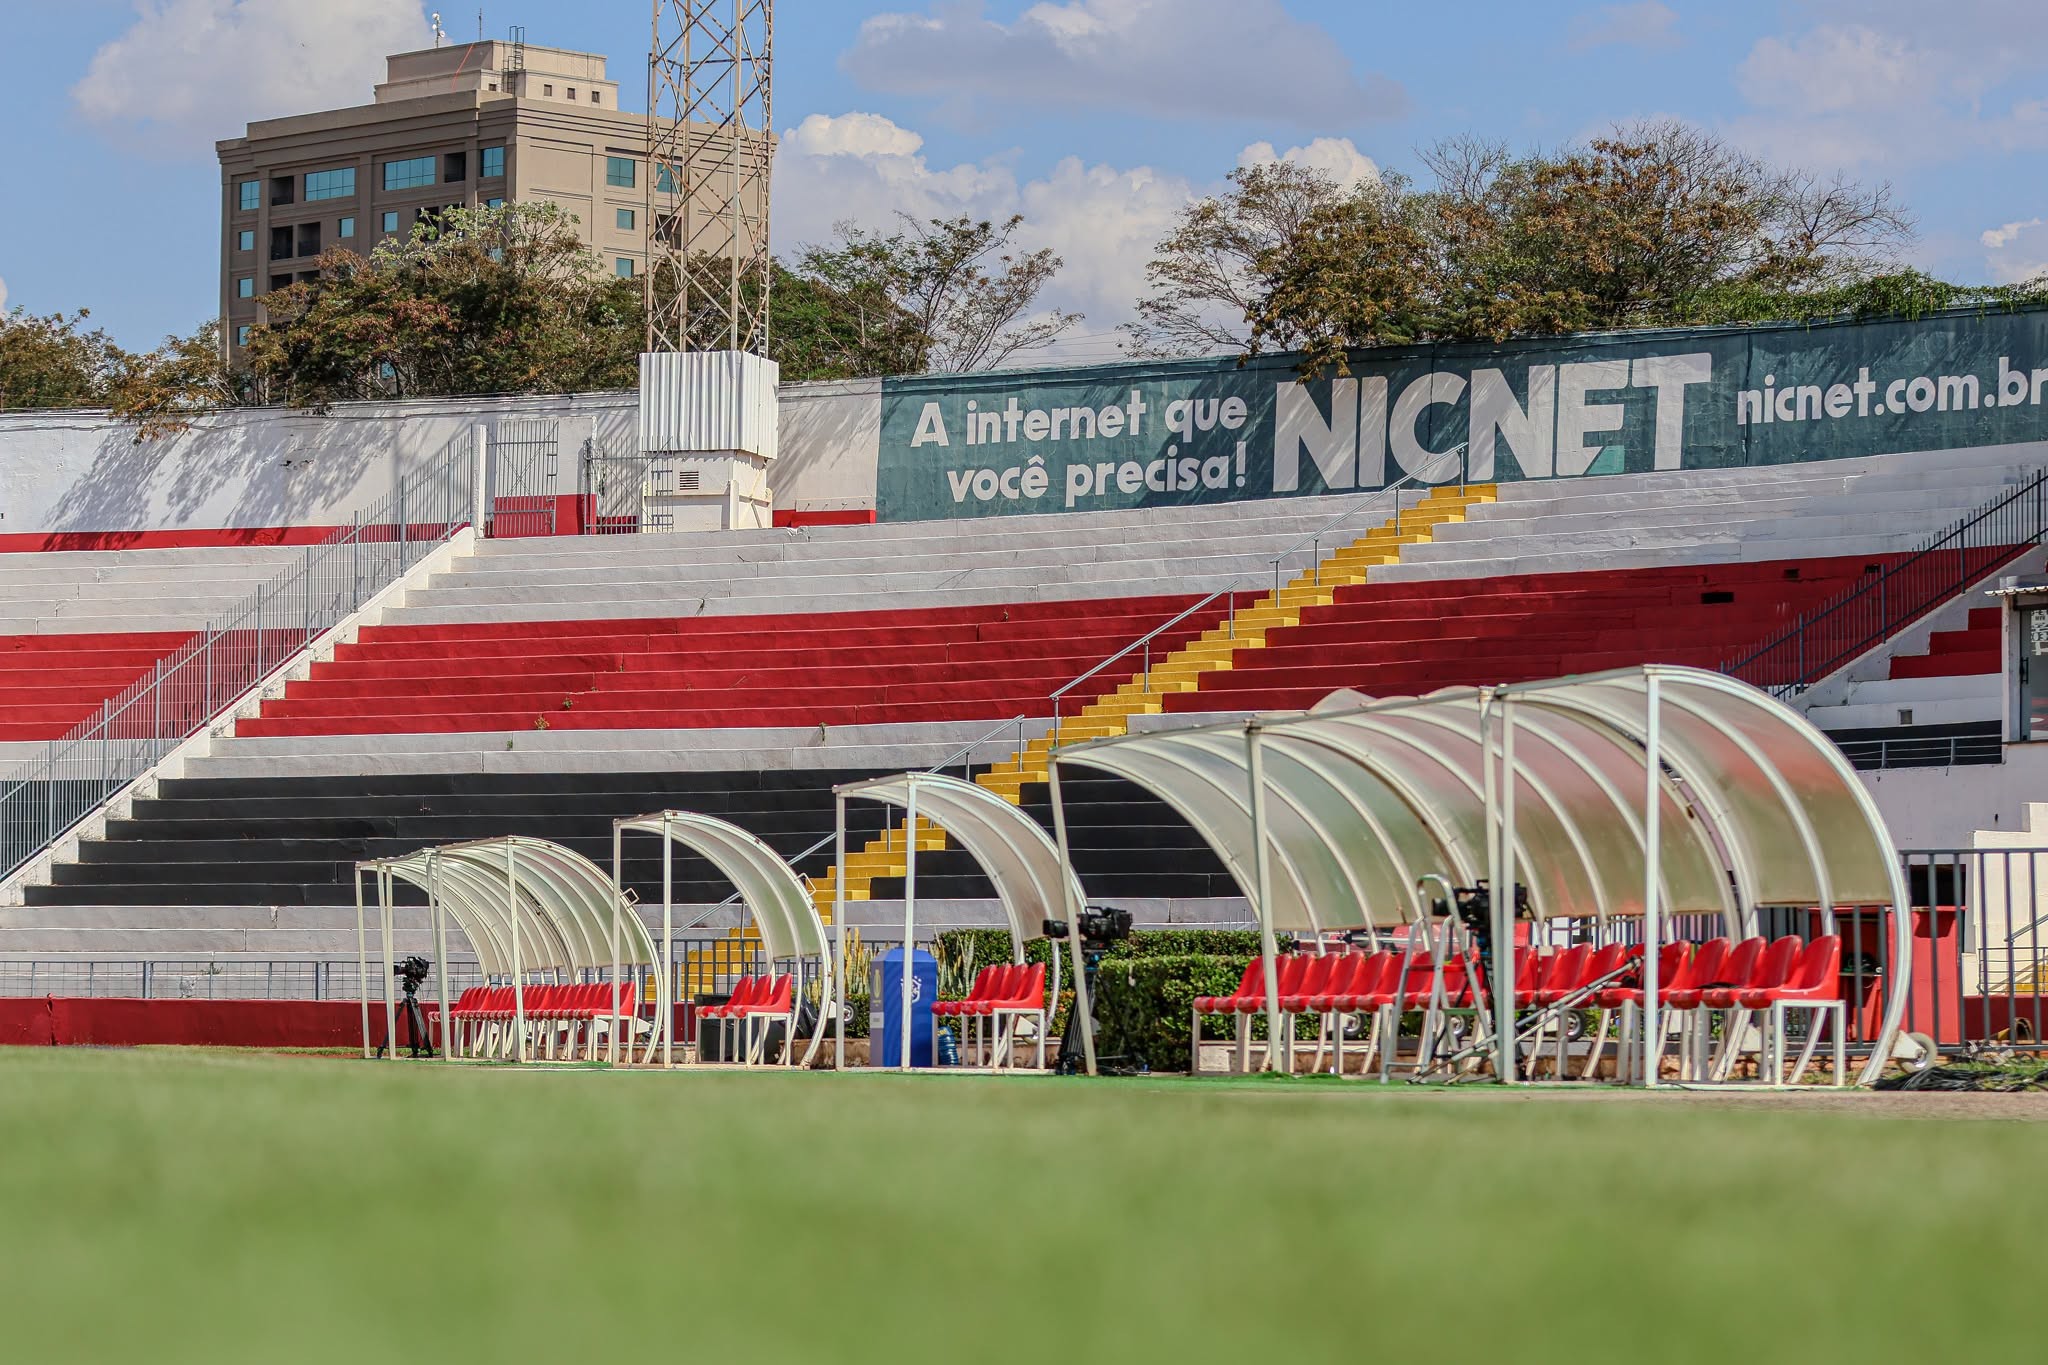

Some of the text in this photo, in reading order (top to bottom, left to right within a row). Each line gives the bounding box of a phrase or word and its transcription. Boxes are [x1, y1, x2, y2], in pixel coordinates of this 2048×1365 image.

[910, 390, 1247, 447] A internet que
[1273, 352, 1711, 493] NICNET
[1738, 356, 2048, 424] nicnet.com.br
[947, 443, 1246, 507] você precisa!
